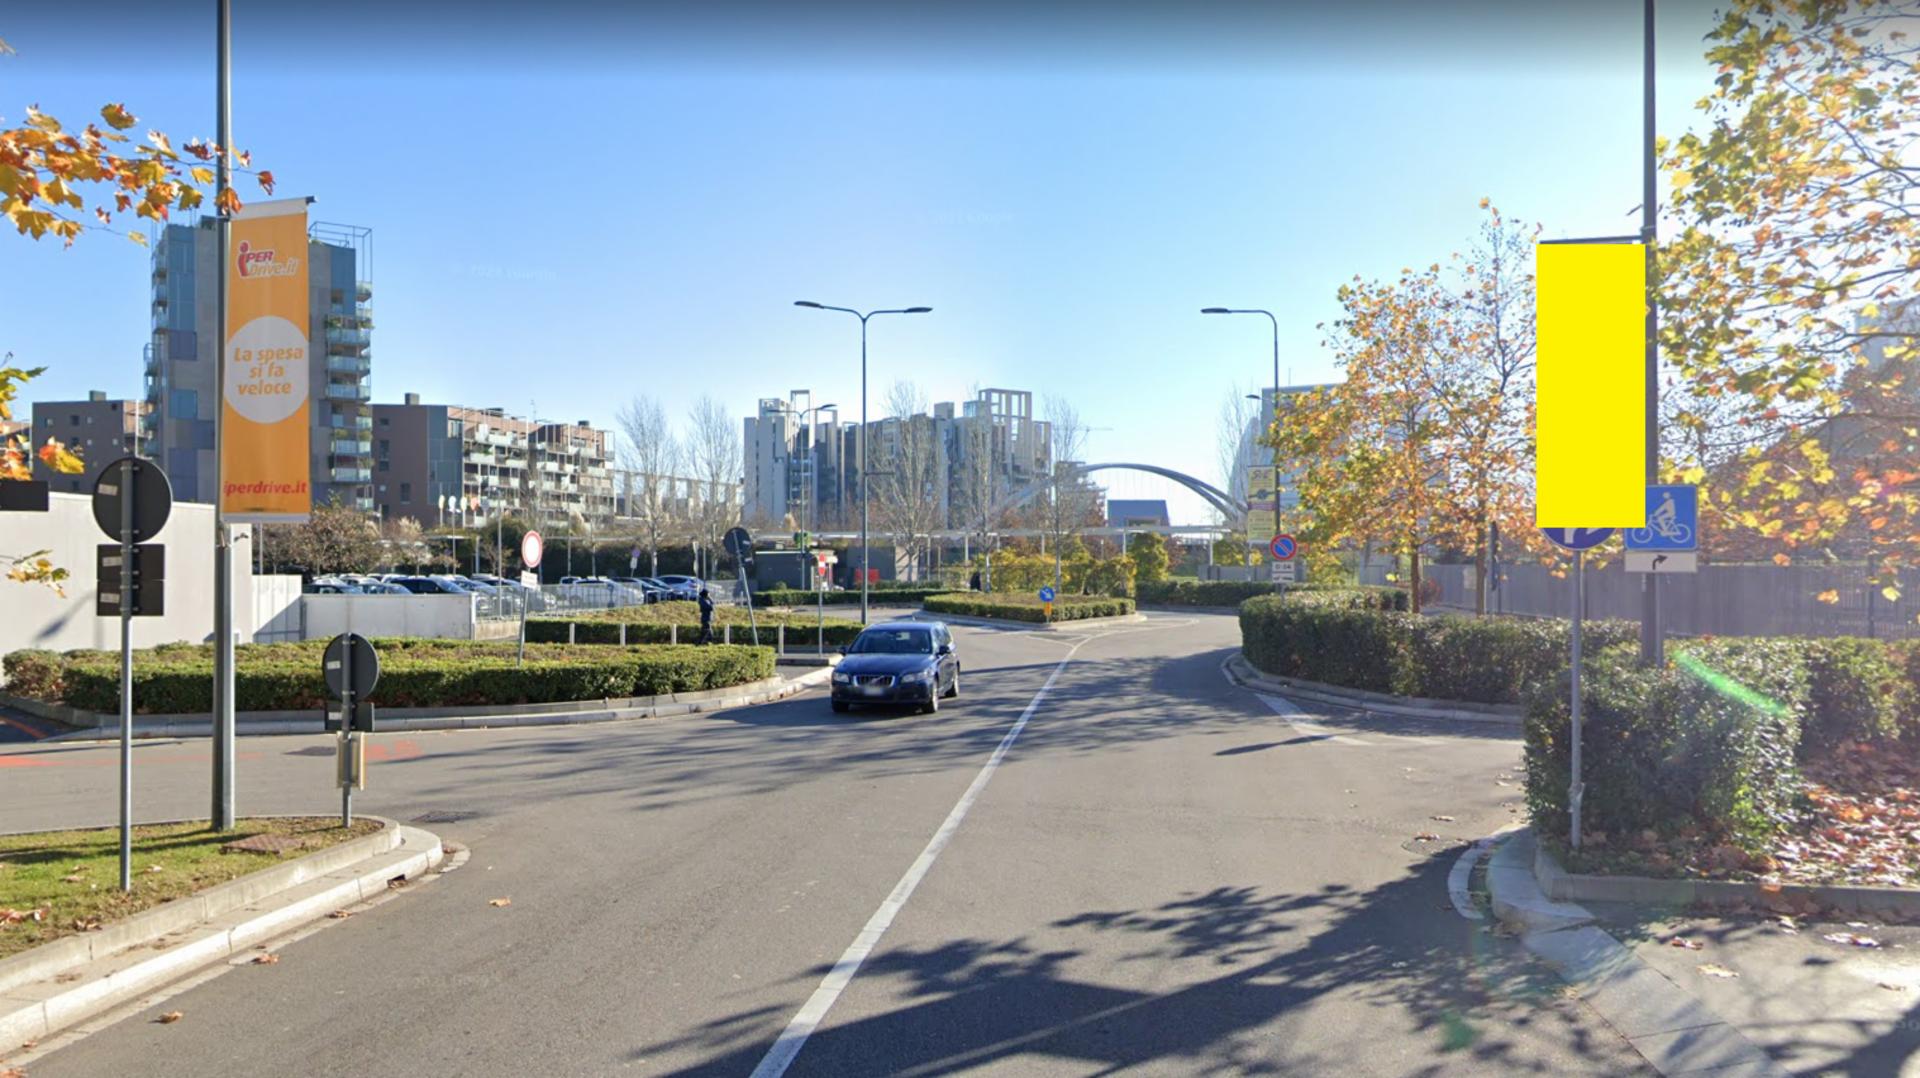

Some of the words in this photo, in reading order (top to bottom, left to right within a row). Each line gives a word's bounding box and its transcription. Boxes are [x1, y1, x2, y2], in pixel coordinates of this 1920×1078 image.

[234, 347, 253, 362] La
[258, 347, 304, 364] spesa
[249, 365, 262, 378] si
[268, 361, 285, 377] fa
[238, 380, 292, 395] veloce
[224, 481, 307, 497] iperdrive.it
